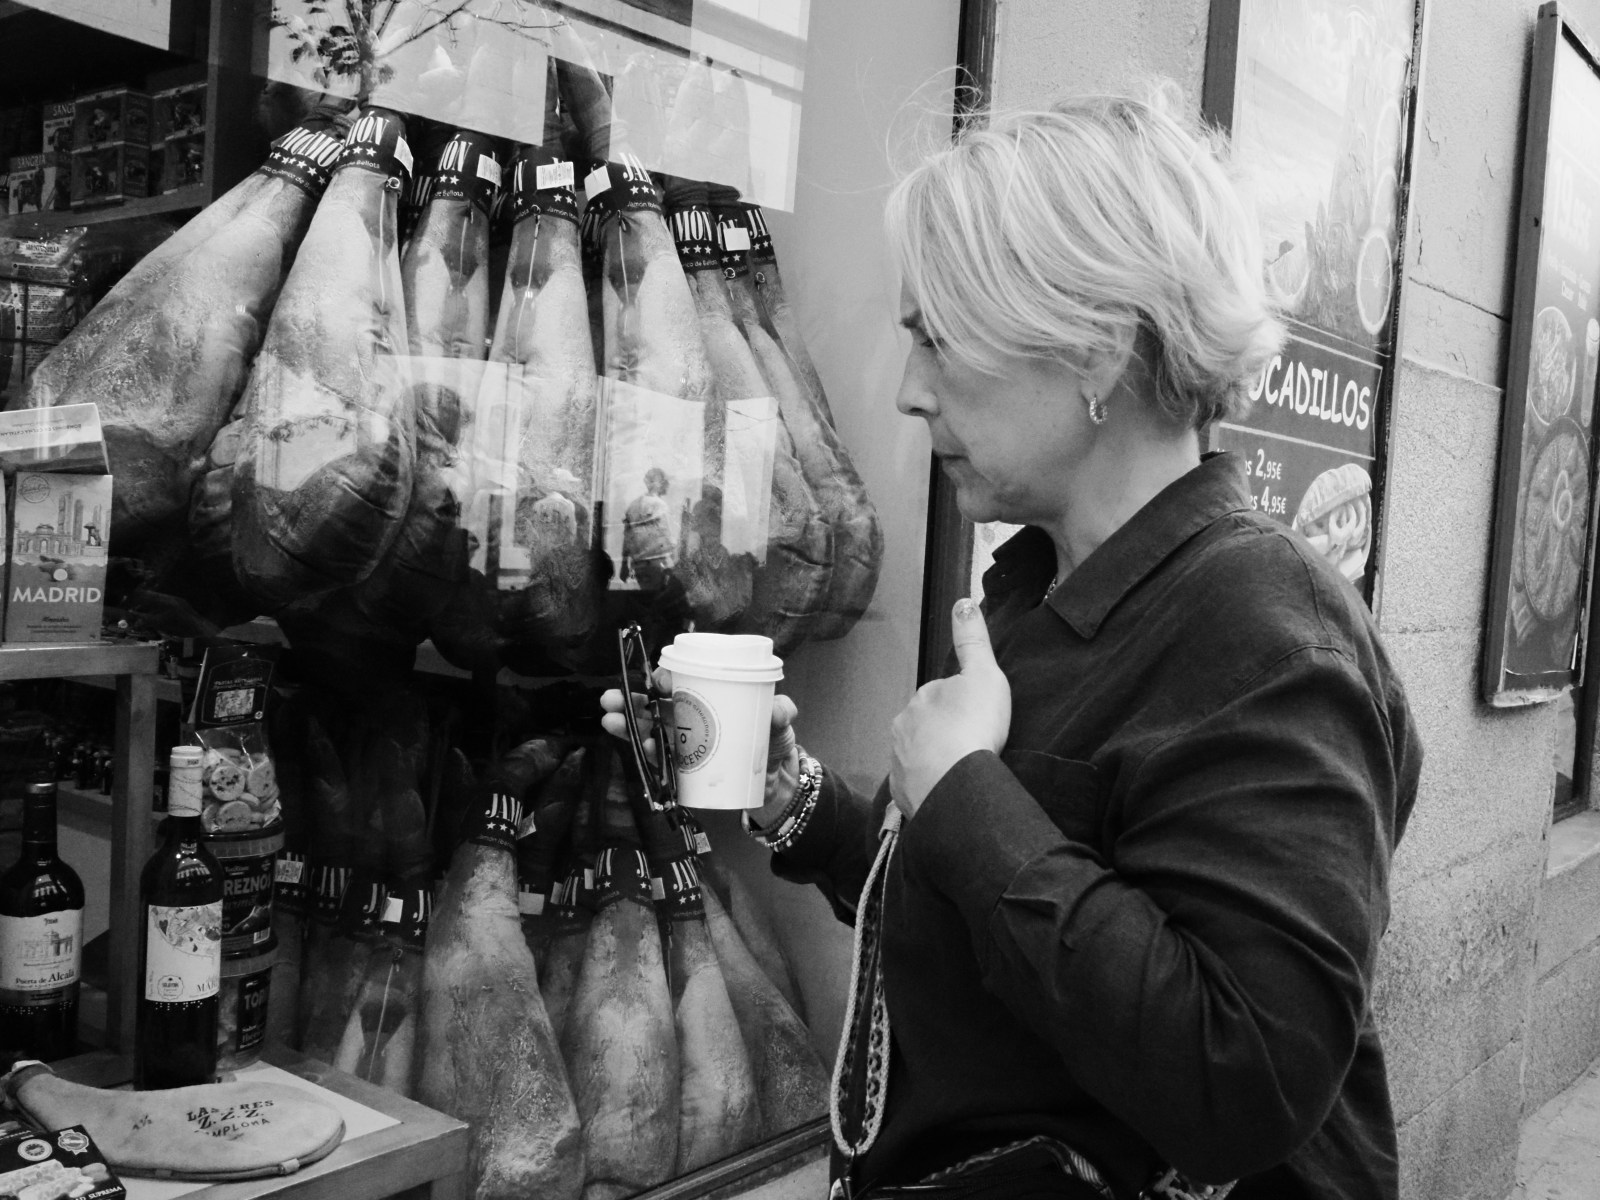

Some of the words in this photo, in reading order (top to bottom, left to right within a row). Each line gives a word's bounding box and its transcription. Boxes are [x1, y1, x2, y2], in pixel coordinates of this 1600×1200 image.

[1255, 448, 1283, 481] 2,95€
[1260, 485, 1287, 516] 4,95€
[12, 586, 102, 603] MADRID
[88, 1185, 123, 1199] SUPREMA
